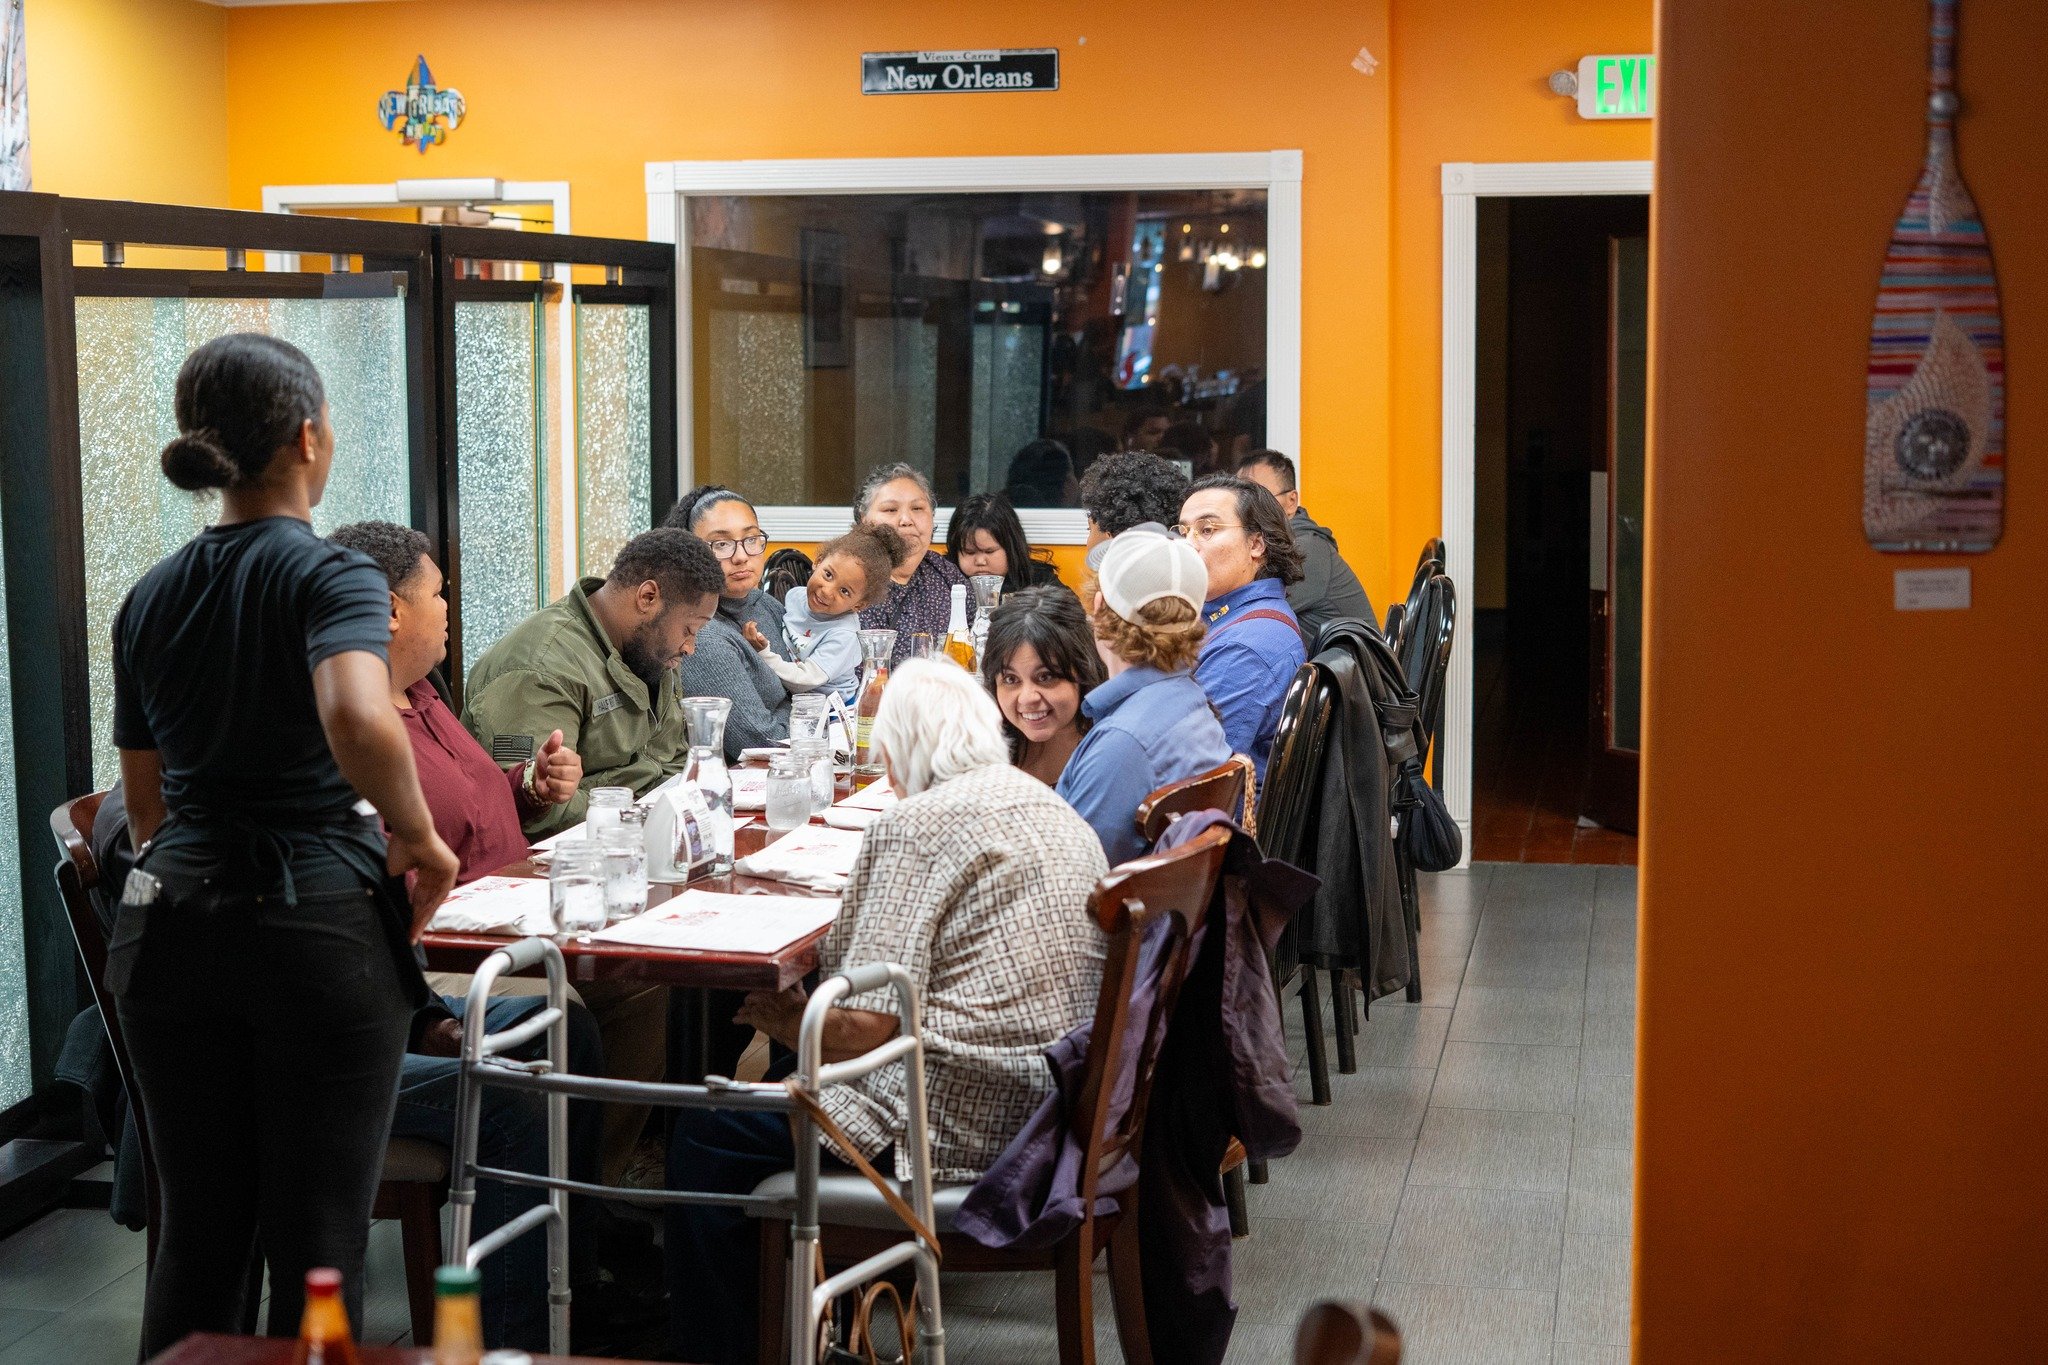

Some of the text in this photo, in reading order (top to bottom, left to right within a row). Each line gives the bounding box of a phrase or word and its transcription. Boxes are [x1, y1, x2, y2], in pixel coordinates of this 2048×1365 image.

[886, 64, 1034, 90] New Orleans
[1596, 57, 1656, 114] EXI
